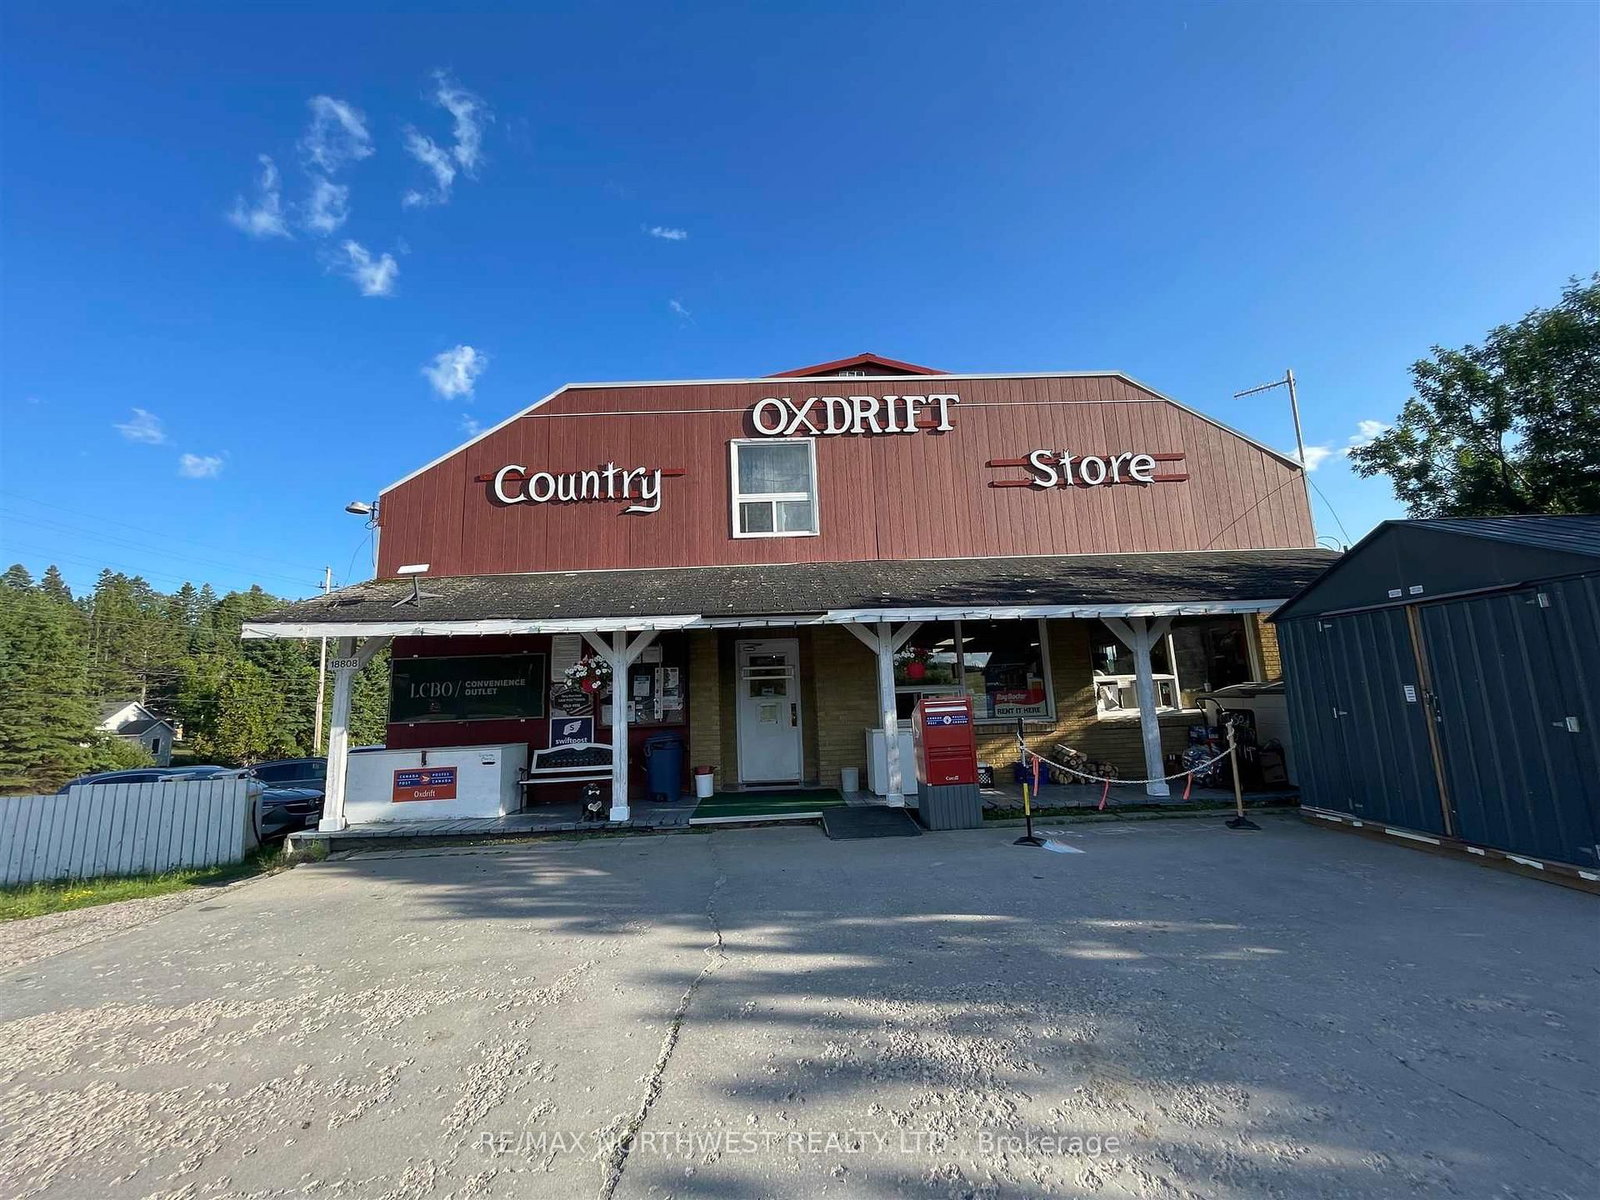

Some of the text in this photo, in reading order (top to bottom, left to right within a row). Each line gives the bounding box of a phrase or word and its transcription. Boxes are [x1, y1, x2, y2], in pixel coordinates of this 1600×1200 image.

[752, 394, 960, 436] OXDRIFT
[1030, 449, 1156, 488] Store
[494, 461, 662, 513] Country
[330, 659, 358, 669] 18808
[465, 679, 526, 687] CONVENIENCE
[410, 681, 453, 699] LCBO
[465, 688, 498, 696] OUTLET
[997, 707, 1014, 715] RENT
[1023, 706, 1041, 714] HERE
[555, 736, 588, 744] swiftpost
[413, 789, 436, 798] Oxdrift
